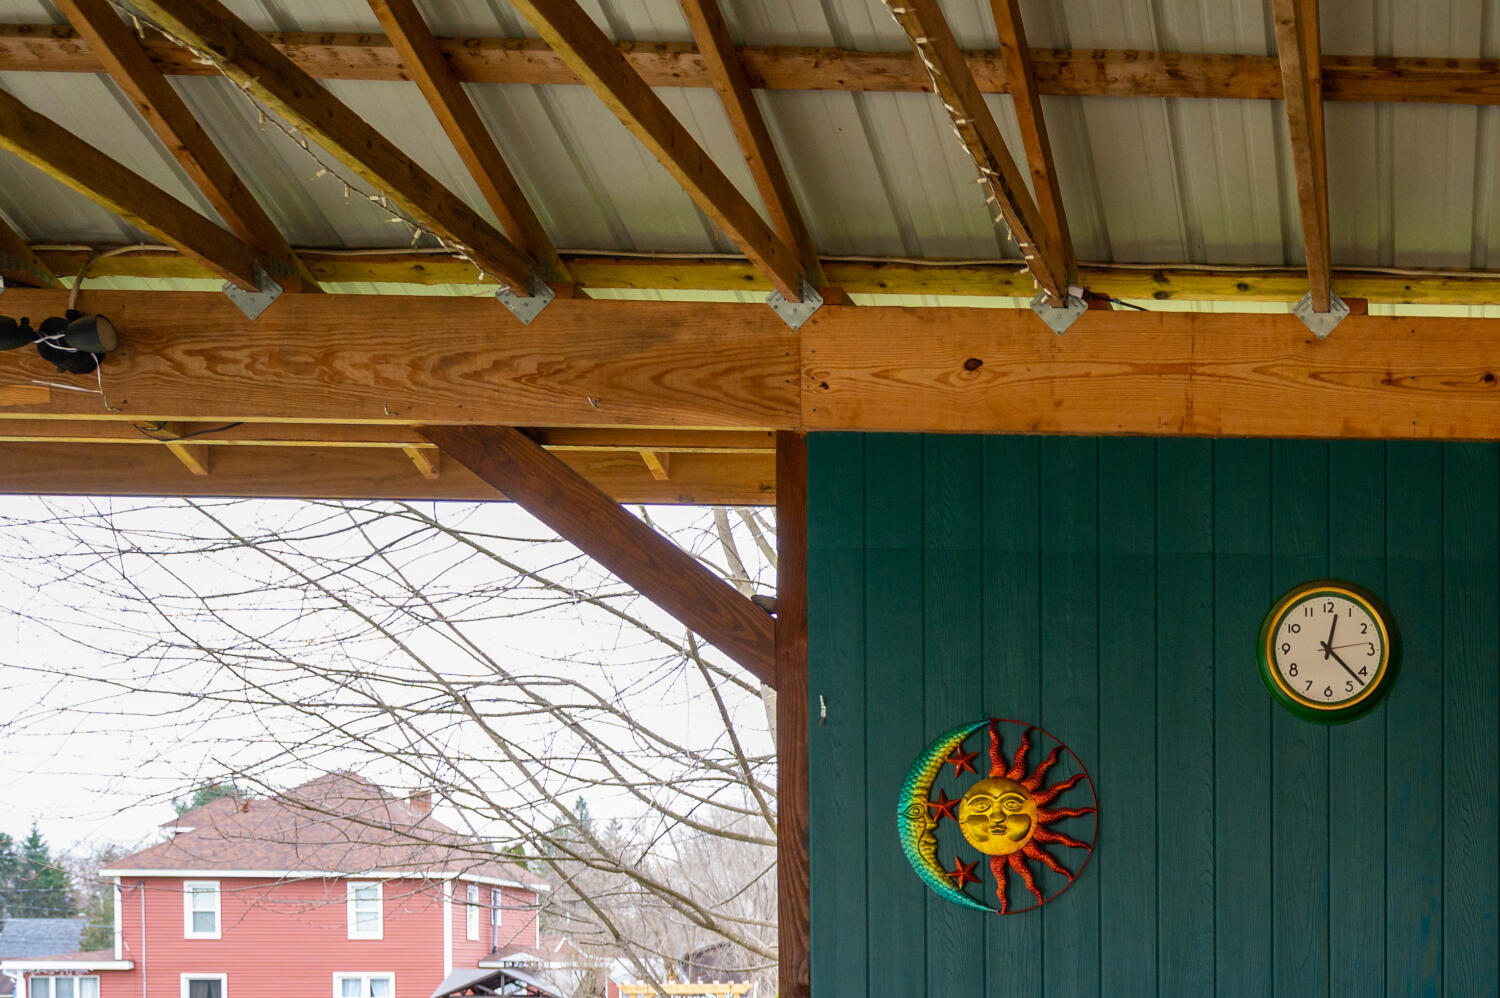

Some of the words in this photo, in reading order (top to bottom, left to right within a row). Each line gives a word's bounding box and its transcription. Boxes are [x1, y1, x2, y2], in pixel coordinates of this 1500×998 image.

[1304, 607, 1314, 617] 11
[1323, 601, 1335, 614] 12
[1287, 623, 1301, 634] 10
[1360, 622, 1368, 635] 2
[1281, 642, 1291, 655] 9
[1366, 642, 1376, 656] 3
[1288, 662, 1299, 677] 8
[1358, 665, 1369, 677] 4
[1305, 680, 1313, 691] 7
[1323, 685, 1333, 697] 6
[1344, 680, 1354, 692] 5
